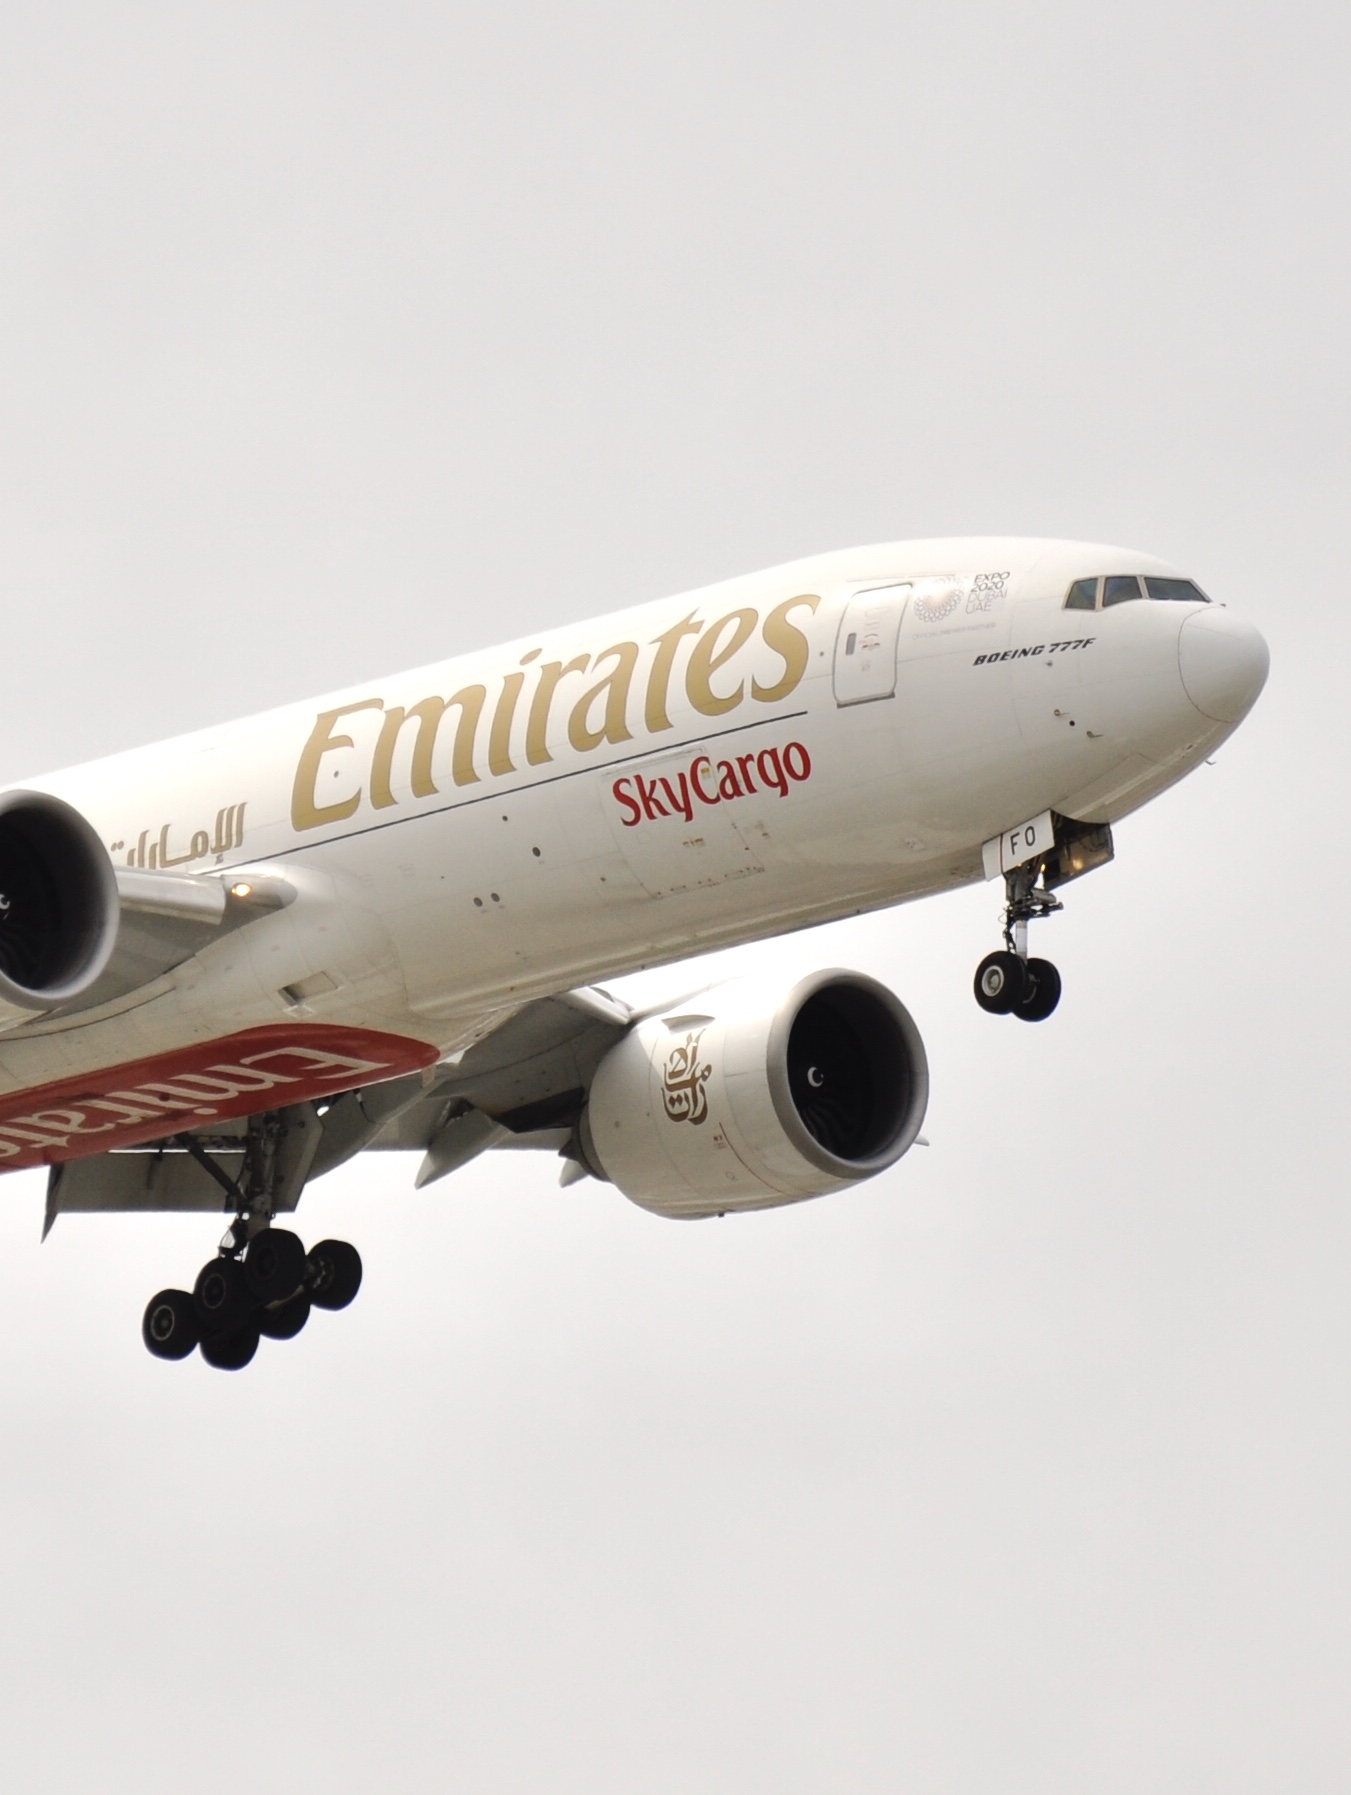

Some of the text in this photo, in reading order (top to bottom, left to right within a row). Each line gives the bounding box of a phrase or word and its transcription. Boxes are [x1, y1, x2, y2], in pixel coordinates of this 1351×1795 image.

[974, 571, 1011, 583] EXPO
[970, 580, 1005, 592] 2020
[967, 589, 1008, 604] DUBAI
[965, 602, 992, 614] UAE
[973, 637, 1097, 667] BOEING 777F
[290, 593, 822, 832] Emirates
[611, 741, 812, 828] SkyCargo
